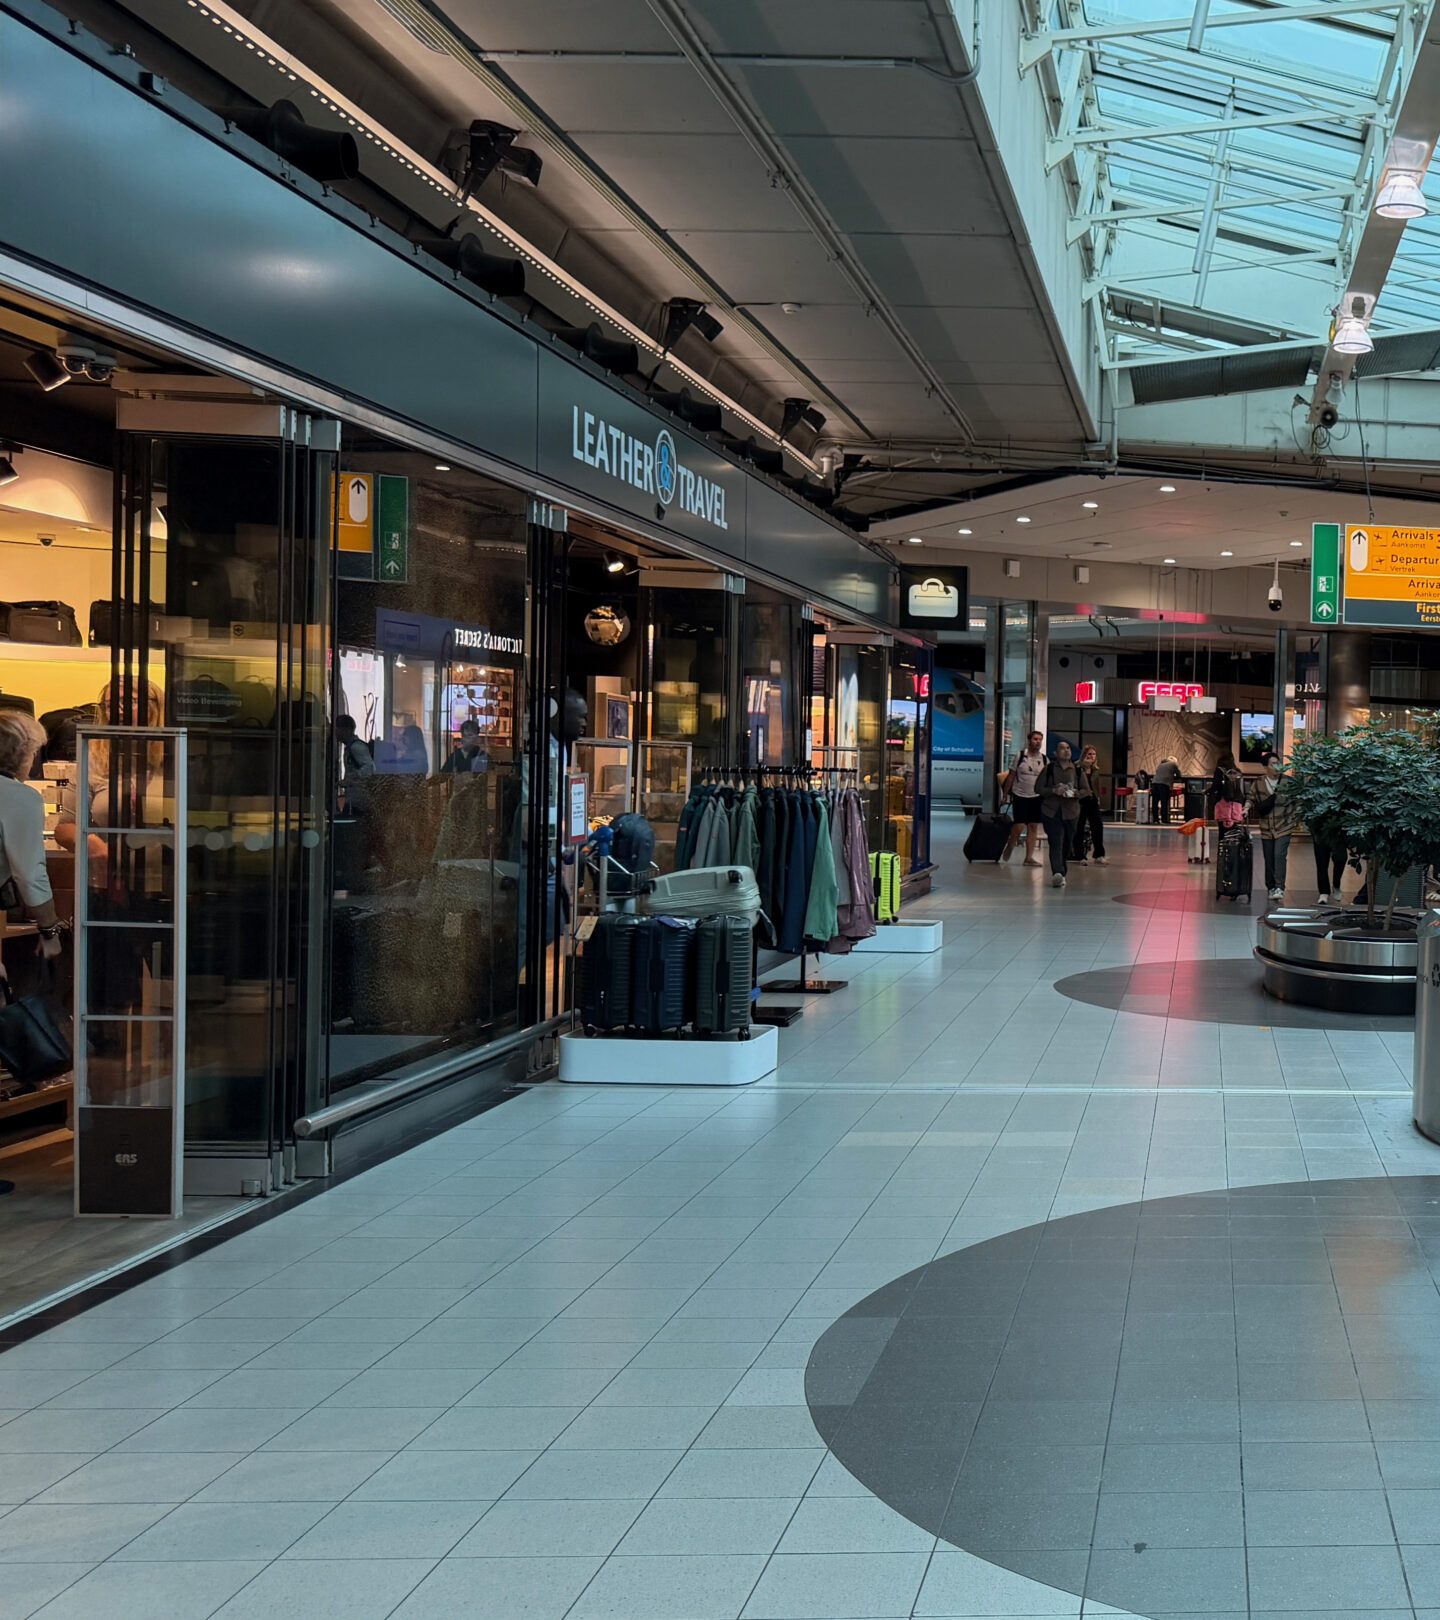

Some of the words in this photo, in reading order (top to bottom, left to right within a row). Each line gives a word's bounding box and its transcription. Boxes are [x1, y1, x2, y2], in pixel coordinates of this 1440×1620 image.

[573, 405, 654, 494] LEATHER
[677, 464, 728, 530] TRAVEL
[1391, 530, 1434, 541] Arrivals
[1416, 603, 1440, 614] First
